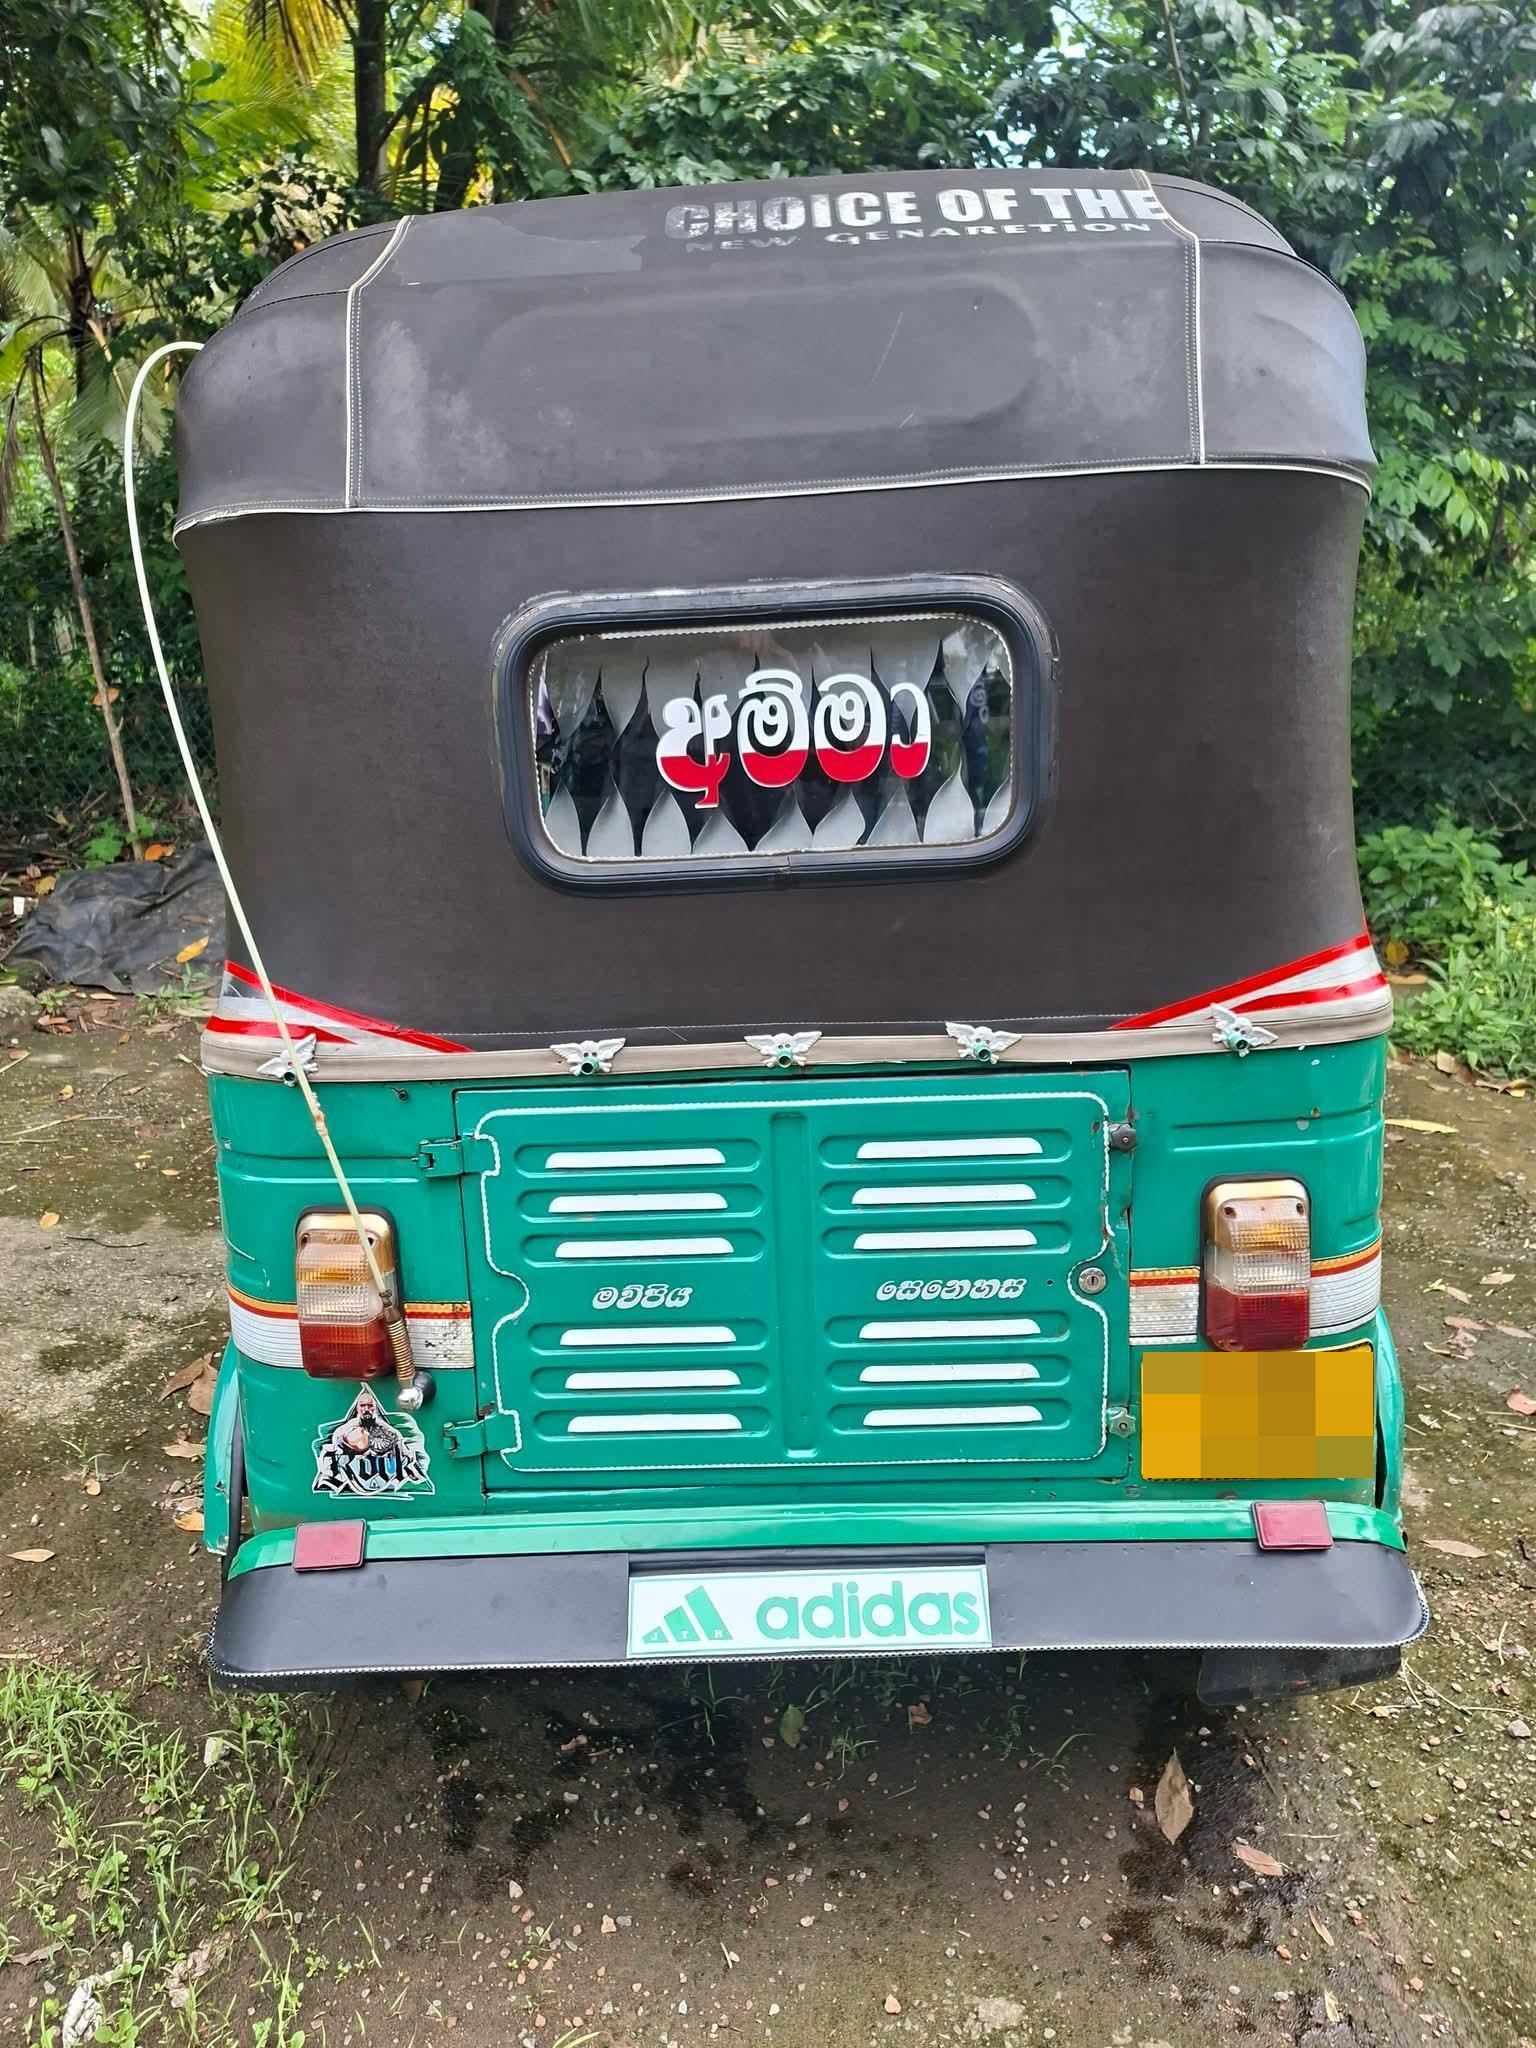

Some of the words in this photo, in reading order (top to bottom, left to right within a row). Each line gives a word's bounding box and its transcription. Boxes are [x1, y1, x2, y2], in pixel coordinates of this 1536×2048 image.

[664, 191, 921, 239] CHOICE
[936, 188, 1018, 222] OF
[1029, 188, 1168, 220] THE
[685, 235, 801, 252] NEW
[656, 669, 932, 809] අම්මා
[756, 1581, 981, 1640] adidas
